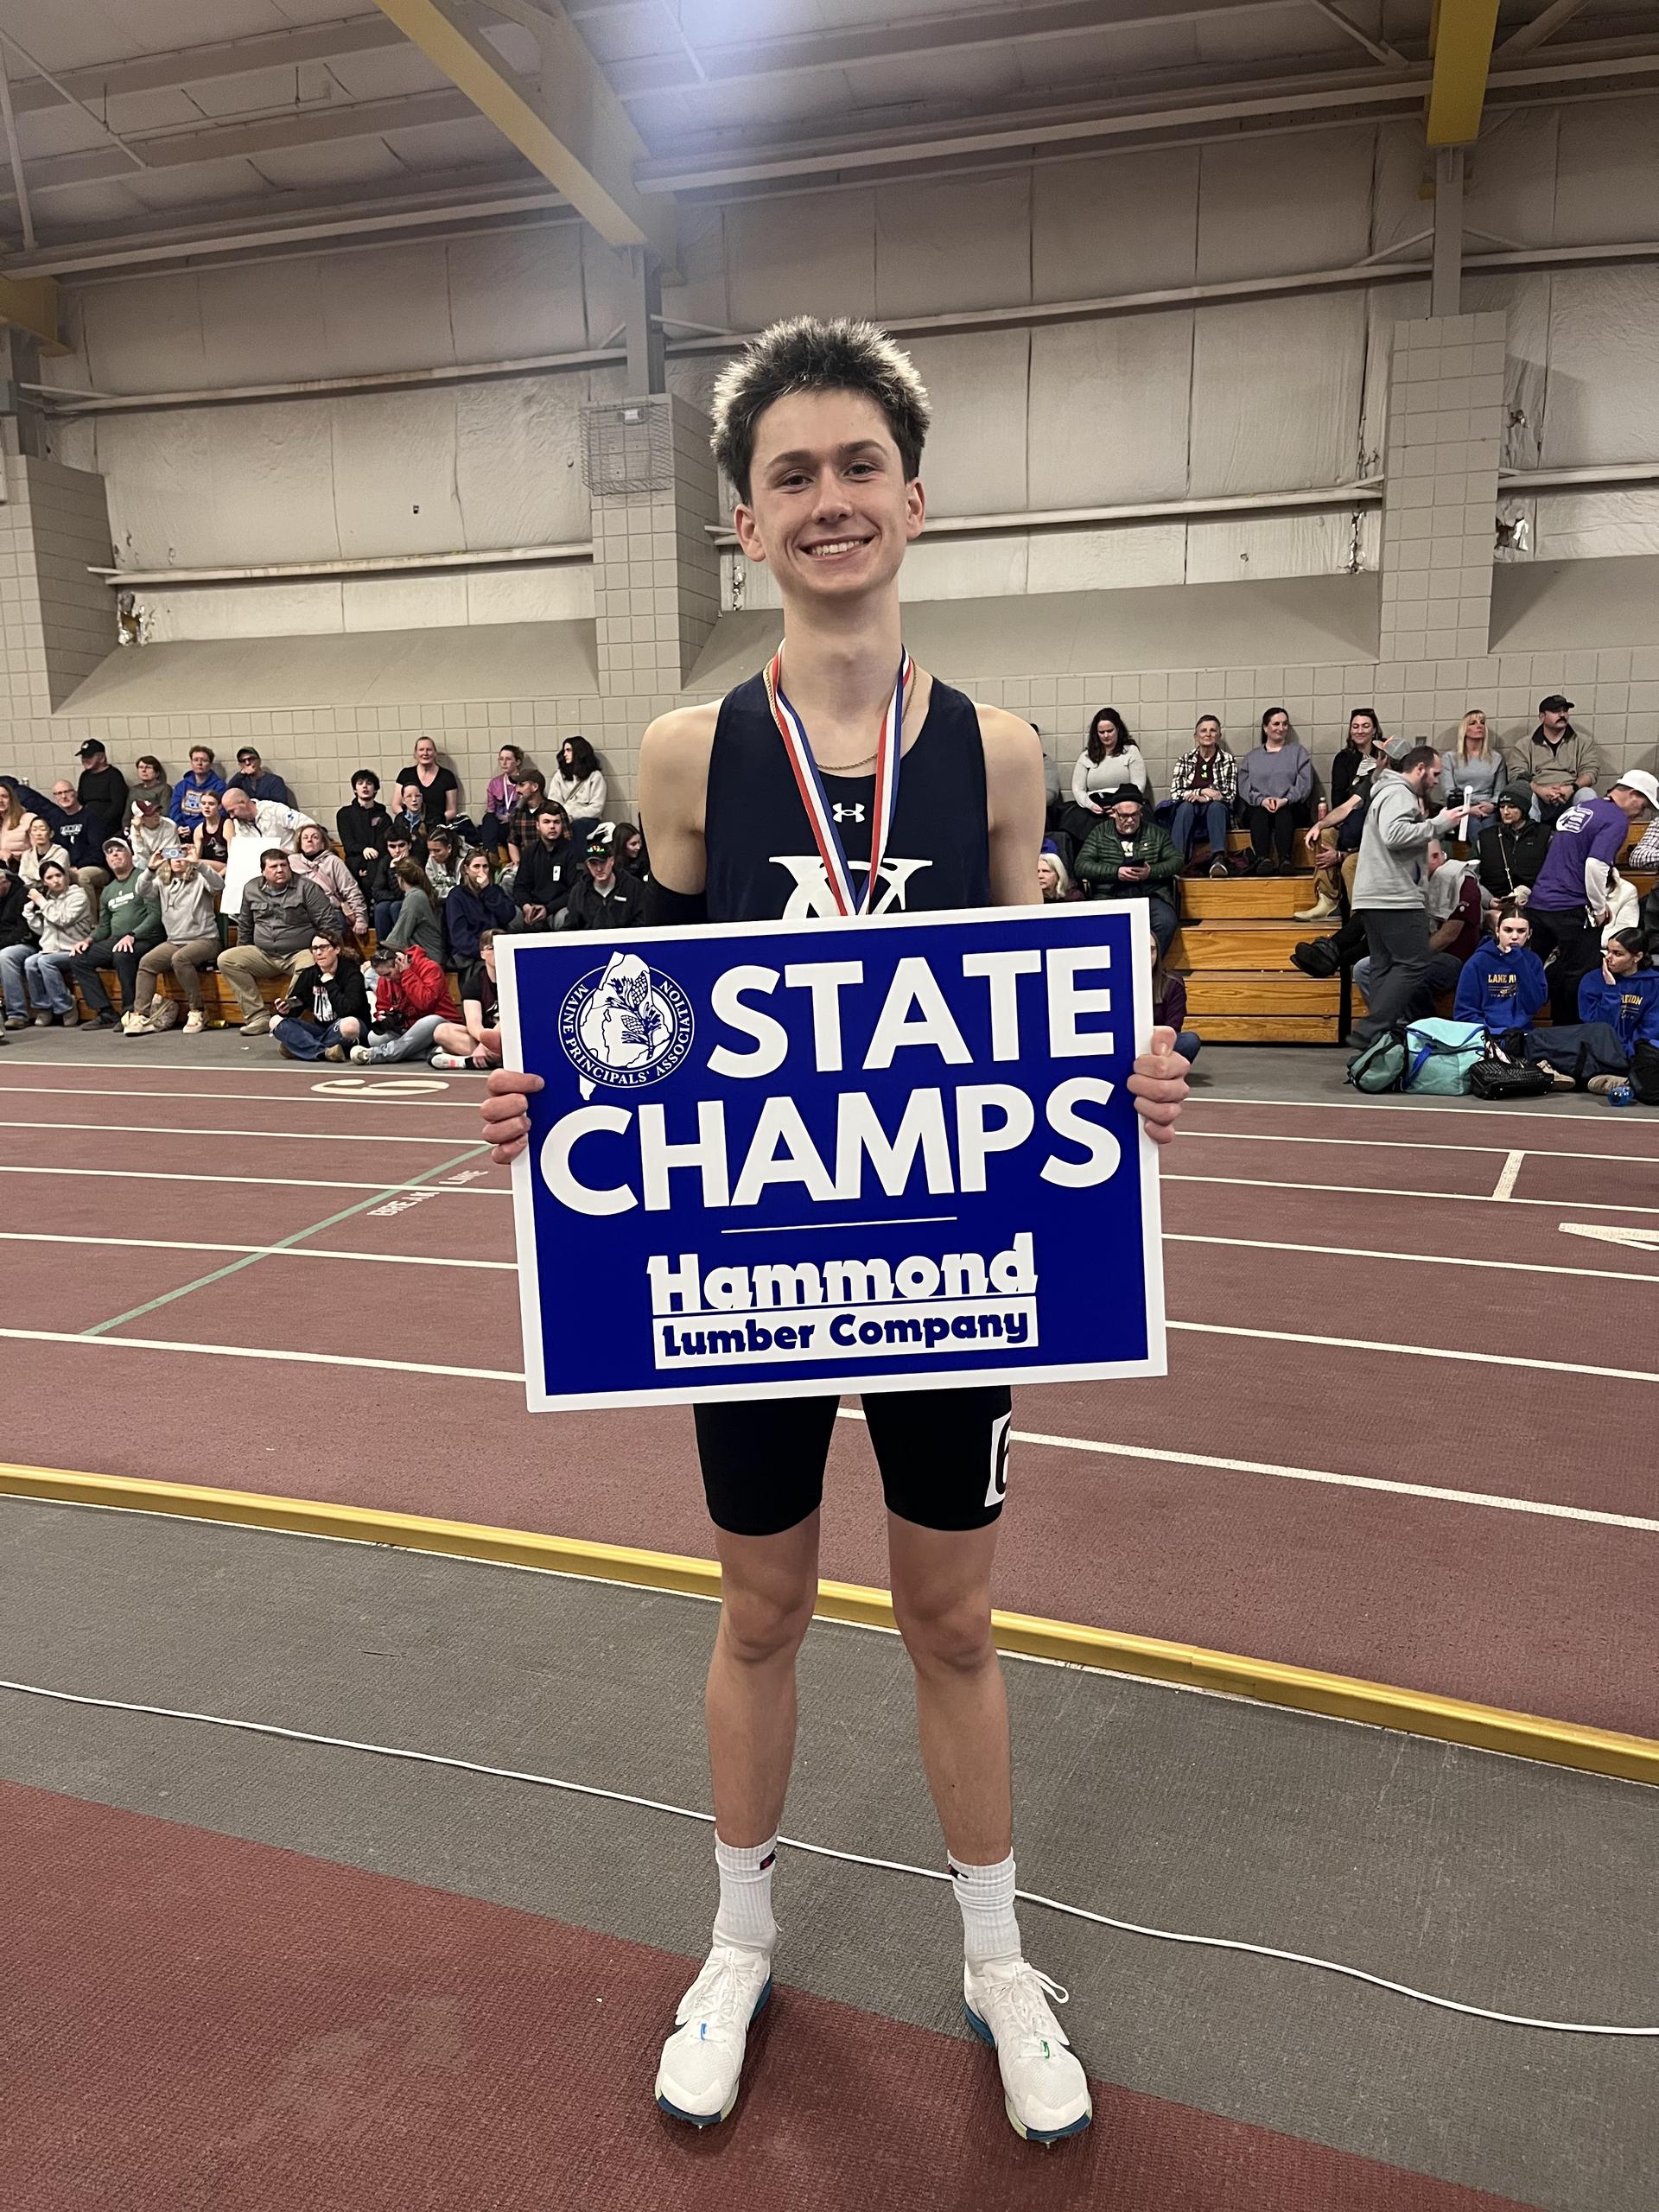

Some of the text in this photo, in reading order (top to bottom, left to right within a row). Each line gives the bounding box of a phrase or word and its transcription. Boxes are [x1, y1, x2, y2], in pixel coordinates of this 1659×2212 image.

[563, 985, 589, 1034] MAINE
[655, 980, 690, 1077] ASSOCIATION
[707, 945, 1114, 1077] STATE
[541, 1077, 1121, 1215] CHAMPS
[646, 1232, 1038, 1316] Hammond
[830, 1312, 1028, 1348] Company
